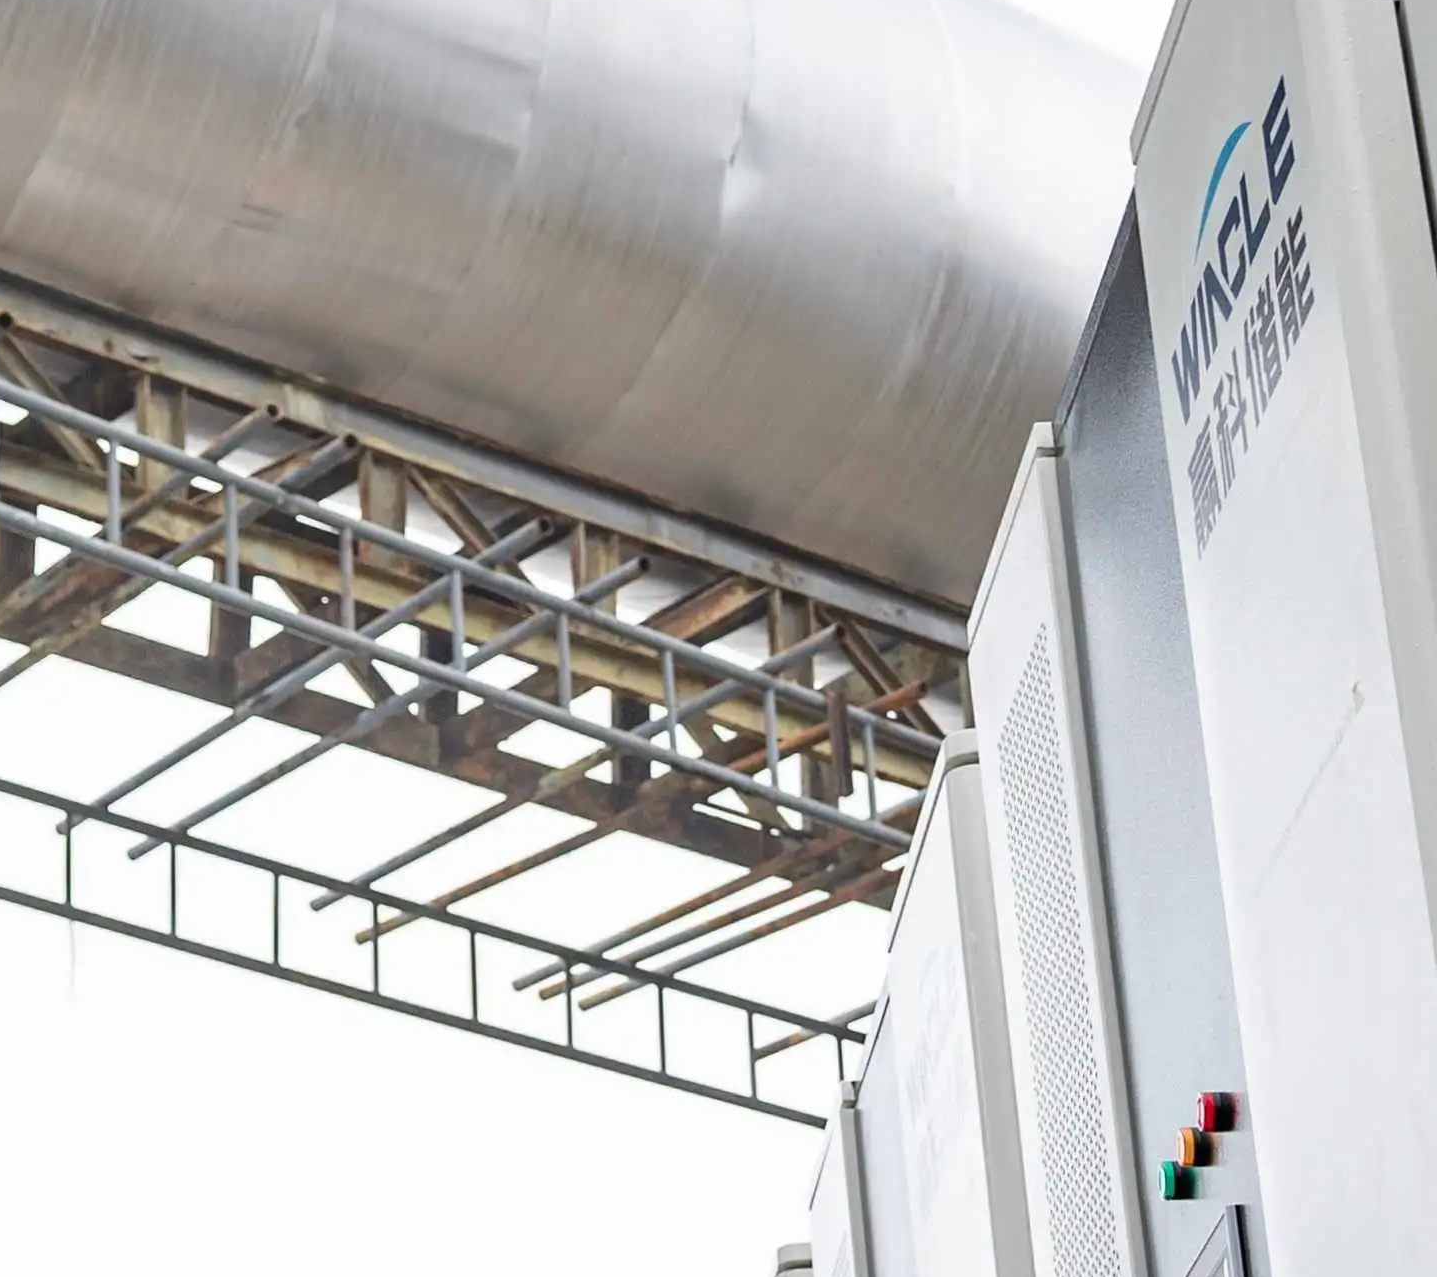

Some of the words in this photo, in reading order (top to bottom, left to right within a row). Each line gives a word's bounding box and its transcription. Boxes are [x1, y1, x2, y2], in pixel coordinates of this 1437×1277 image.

[1170, 74, 1296, 426] WINCLE
[1187, 204, 1316, 554] 赢科储能
